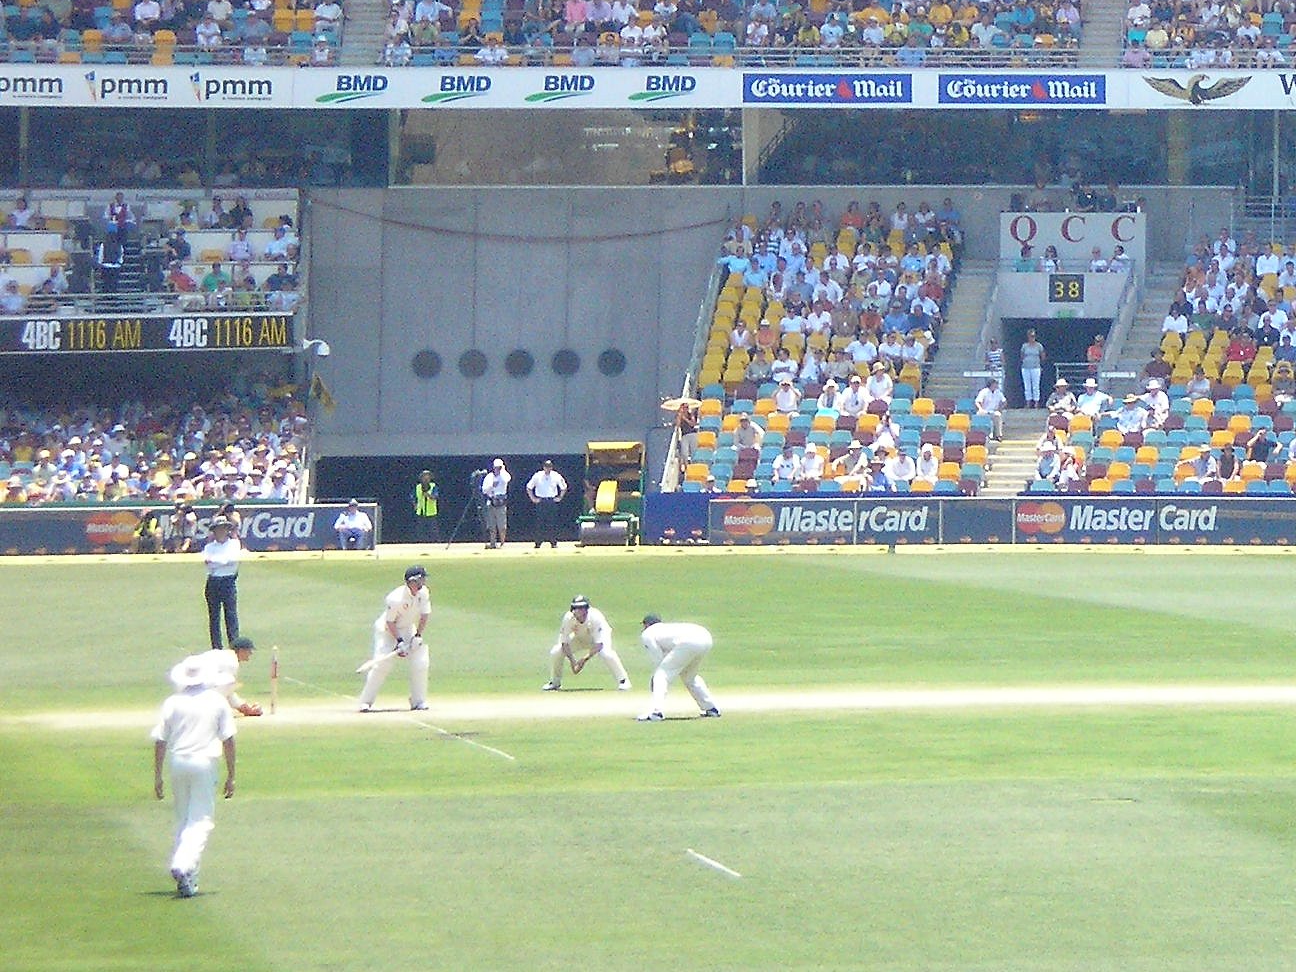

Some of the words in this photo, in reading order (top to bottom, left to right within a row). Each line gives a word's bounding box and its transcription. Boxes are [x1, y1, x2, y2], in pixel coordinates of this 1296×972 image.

[101, 77, 169, 99] pmm
[205, 78, 273, 100] pmm
[336, 75, 389, 92] BMD
[439, 75, 492, 92] BMD
[543, 75, 595, 92] BMD
[645, 75, 697, 92] BMD
[751, 79, 837, 98] Courier
[853, 79, 903, 98] Mail
[946, 80, 1031, 99] Courier
[1048, 80, 1097, 99] Mail
[1054, 281, 1079, 298] 38
[21, 320, 61, 350] 4BC
[67, 321, 106, 349] 1116
[112, 320, 141, 348] AM
[168, 318, 208, 348] 4BC
[214, 319, 252, 346] 1116
[259, 318, 286, 345] AM
[723, 513, 775, 526] MasterCard
[1016, 512, 1066, 525] MasterCard
